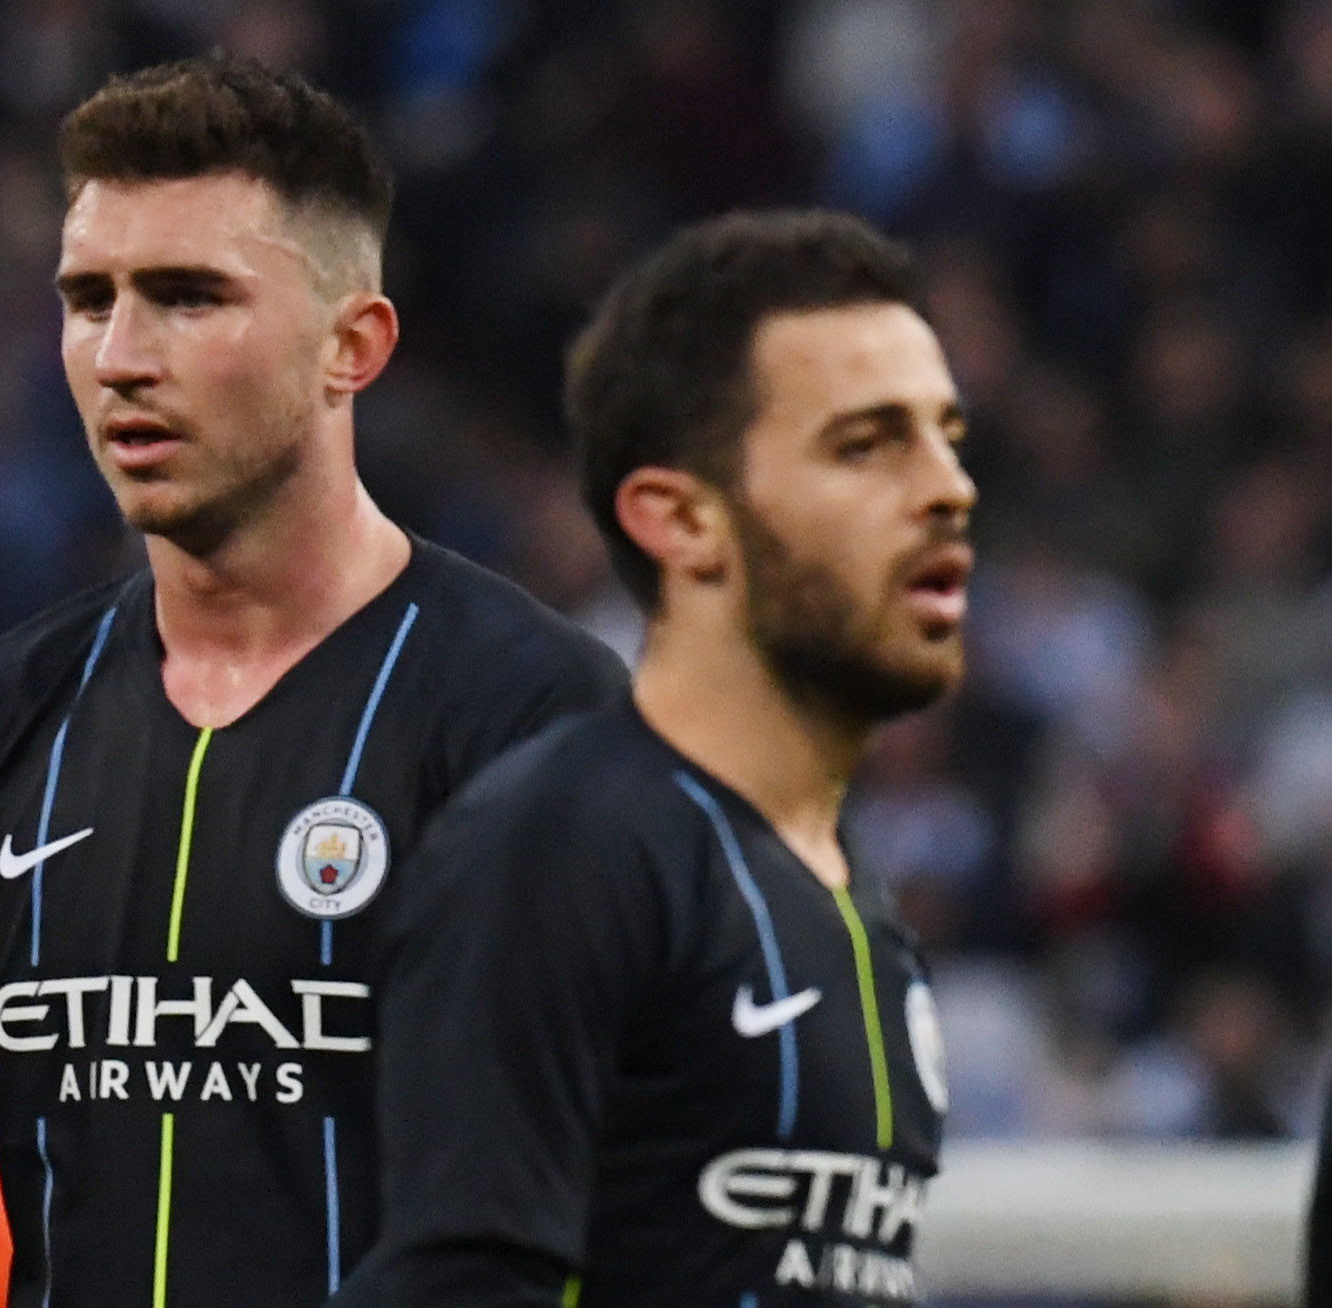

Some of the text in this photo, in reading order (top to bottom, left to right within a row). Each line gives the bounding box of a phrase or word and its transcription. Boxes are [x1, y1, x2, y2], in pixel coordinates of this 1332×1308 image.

[294, 807, 378, 840] MANCHESTER
[310, 899, 341, 909] CITY
[58, 1059, 305, 1104] AIRWAYS
